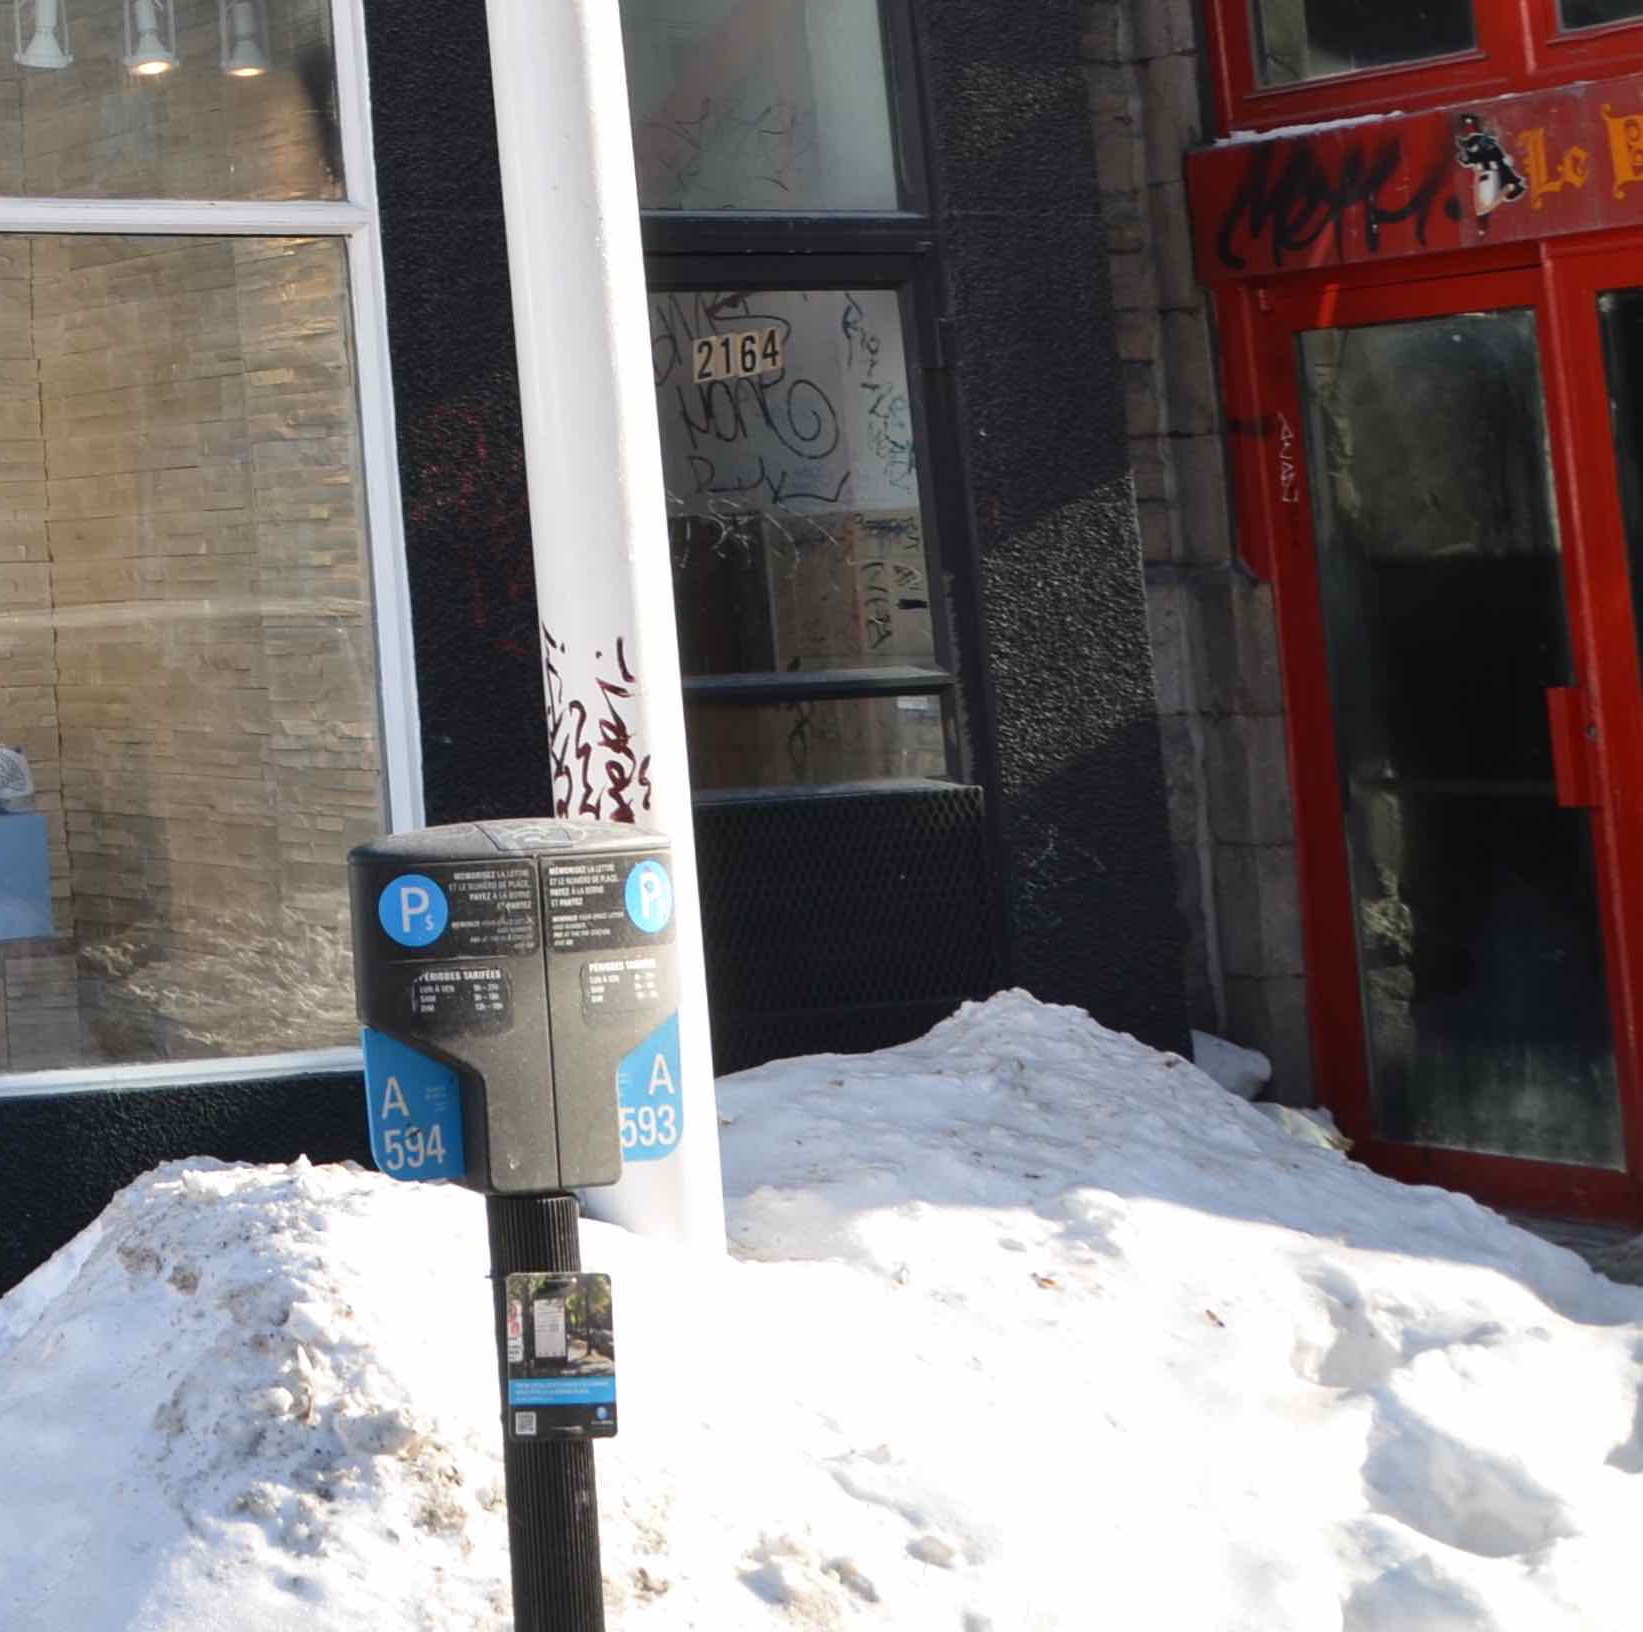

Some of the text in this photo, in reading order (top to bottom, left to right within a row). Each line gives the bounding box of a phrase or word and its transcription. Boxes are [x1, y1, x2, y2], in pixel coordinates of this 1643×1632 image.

[1514, 128, 1591, 209] Le
[696, 329, 780, 381] 2164
[649, 1053, 676, 1096] A
[381, 1077, 410, 1120] A
[383, 1124, 447, 1172] 594
[619, 1105, 677, 1149] 593
